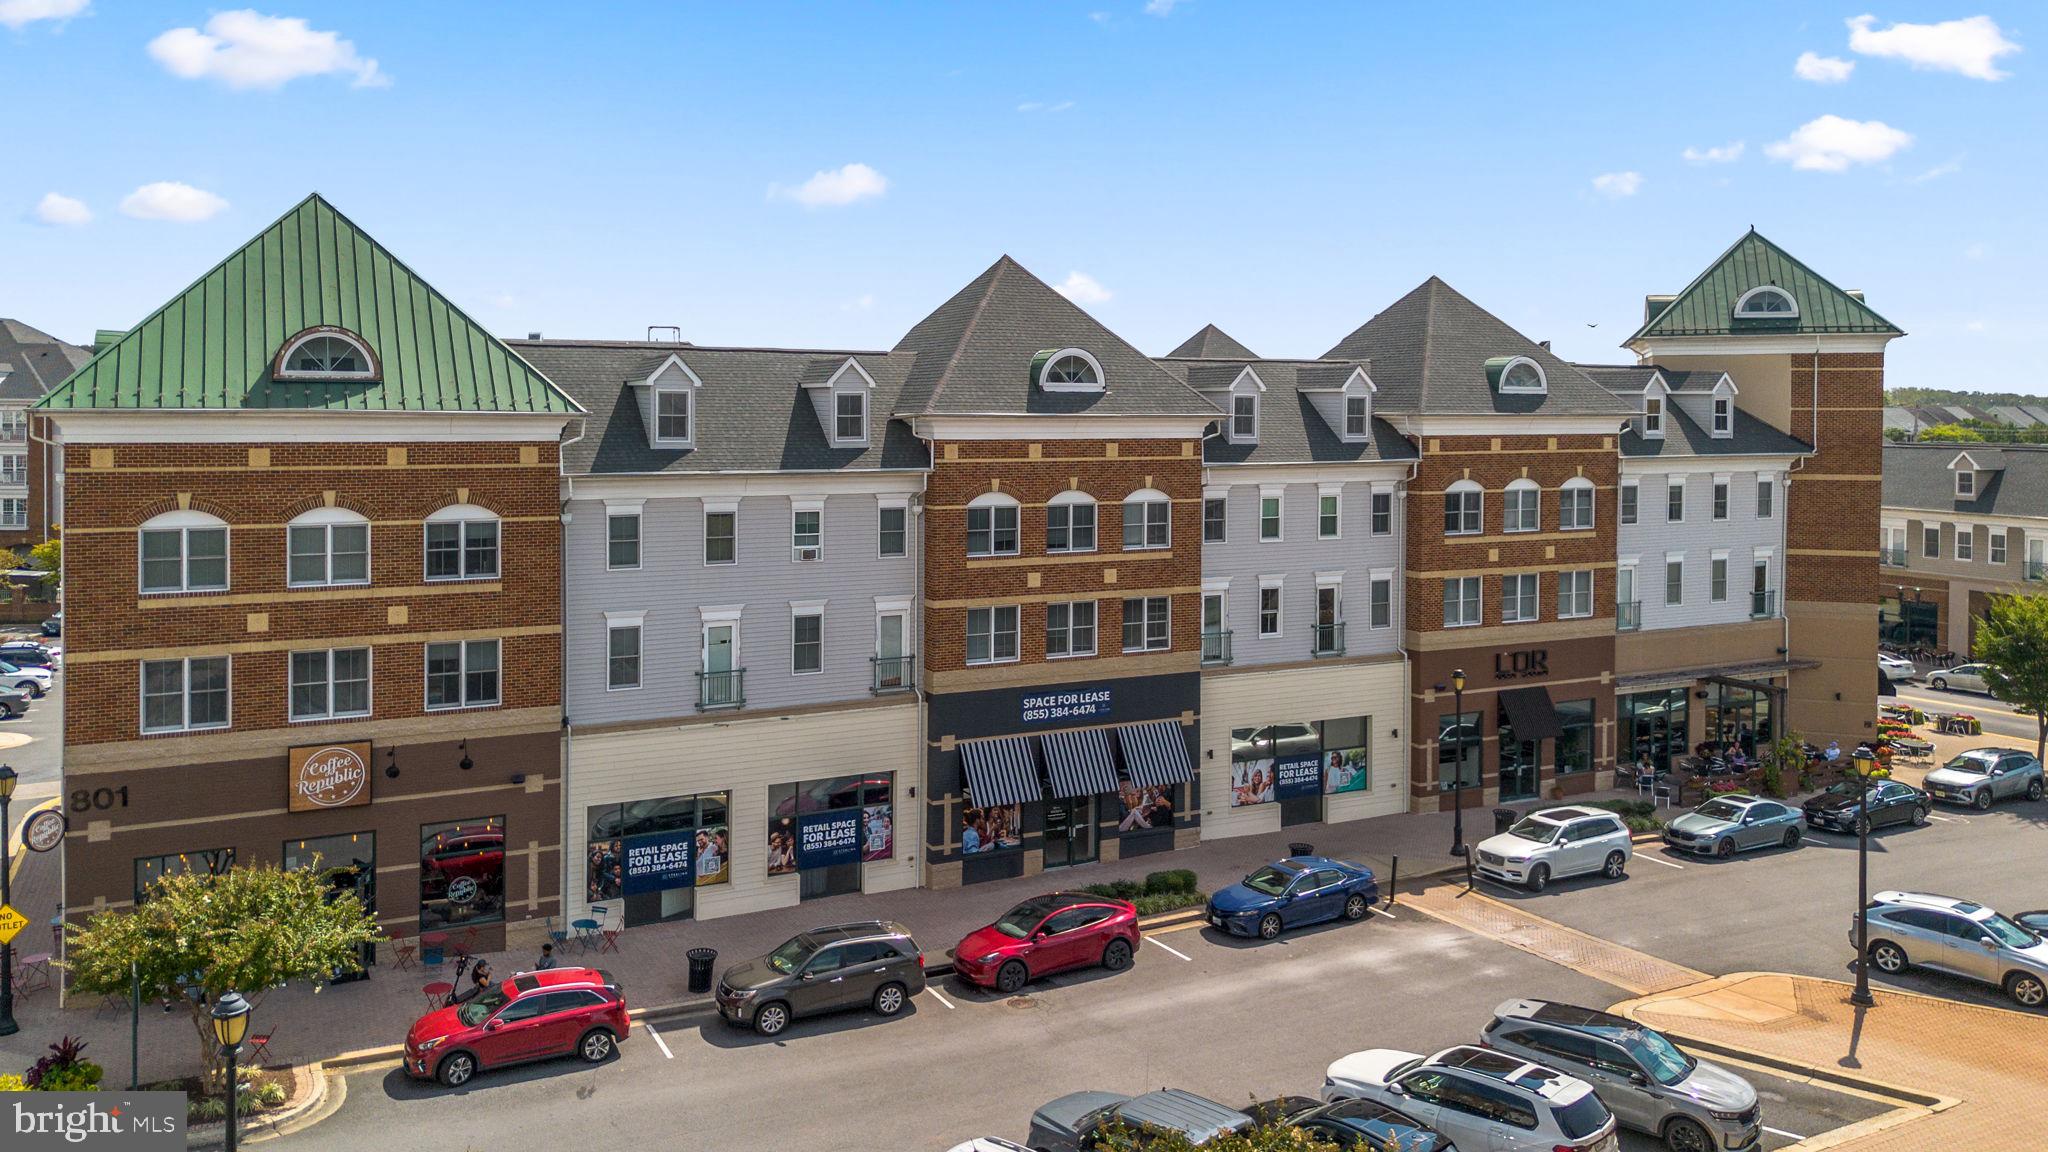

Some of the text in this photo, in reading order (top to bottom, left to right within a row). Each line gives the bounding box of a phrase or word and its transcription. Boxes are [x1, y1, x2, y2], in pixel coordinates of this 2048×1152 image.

[1023, 691, 1110, 708] SPACE FOR LEASE
[1023, 704, 1096, 721] (855) 384-6474
[307, 756, 352, 776] Coffee
[1279, 760, 1319, 770] RETAIL SPACE
[1279, 767, 1319, 779] FOR LEASE
[296, 768, 362, 795] Republic
[70, 785, 128, 812] 801
[803, 820, 856, 834] RETAIL SPACE
[803, 828, 856, 843] FOR LEASE
[629, 842, 688, 857] RETAIL SPACE
[803, 837, 856, 851] (855) 384-6474
[629, 850, 688, 867] FOR LEASE
[629, 860, 688, 876] (855) 384-6474
[0, 912, 12, 920] NO
[0, 920, 24, 930] TLET
